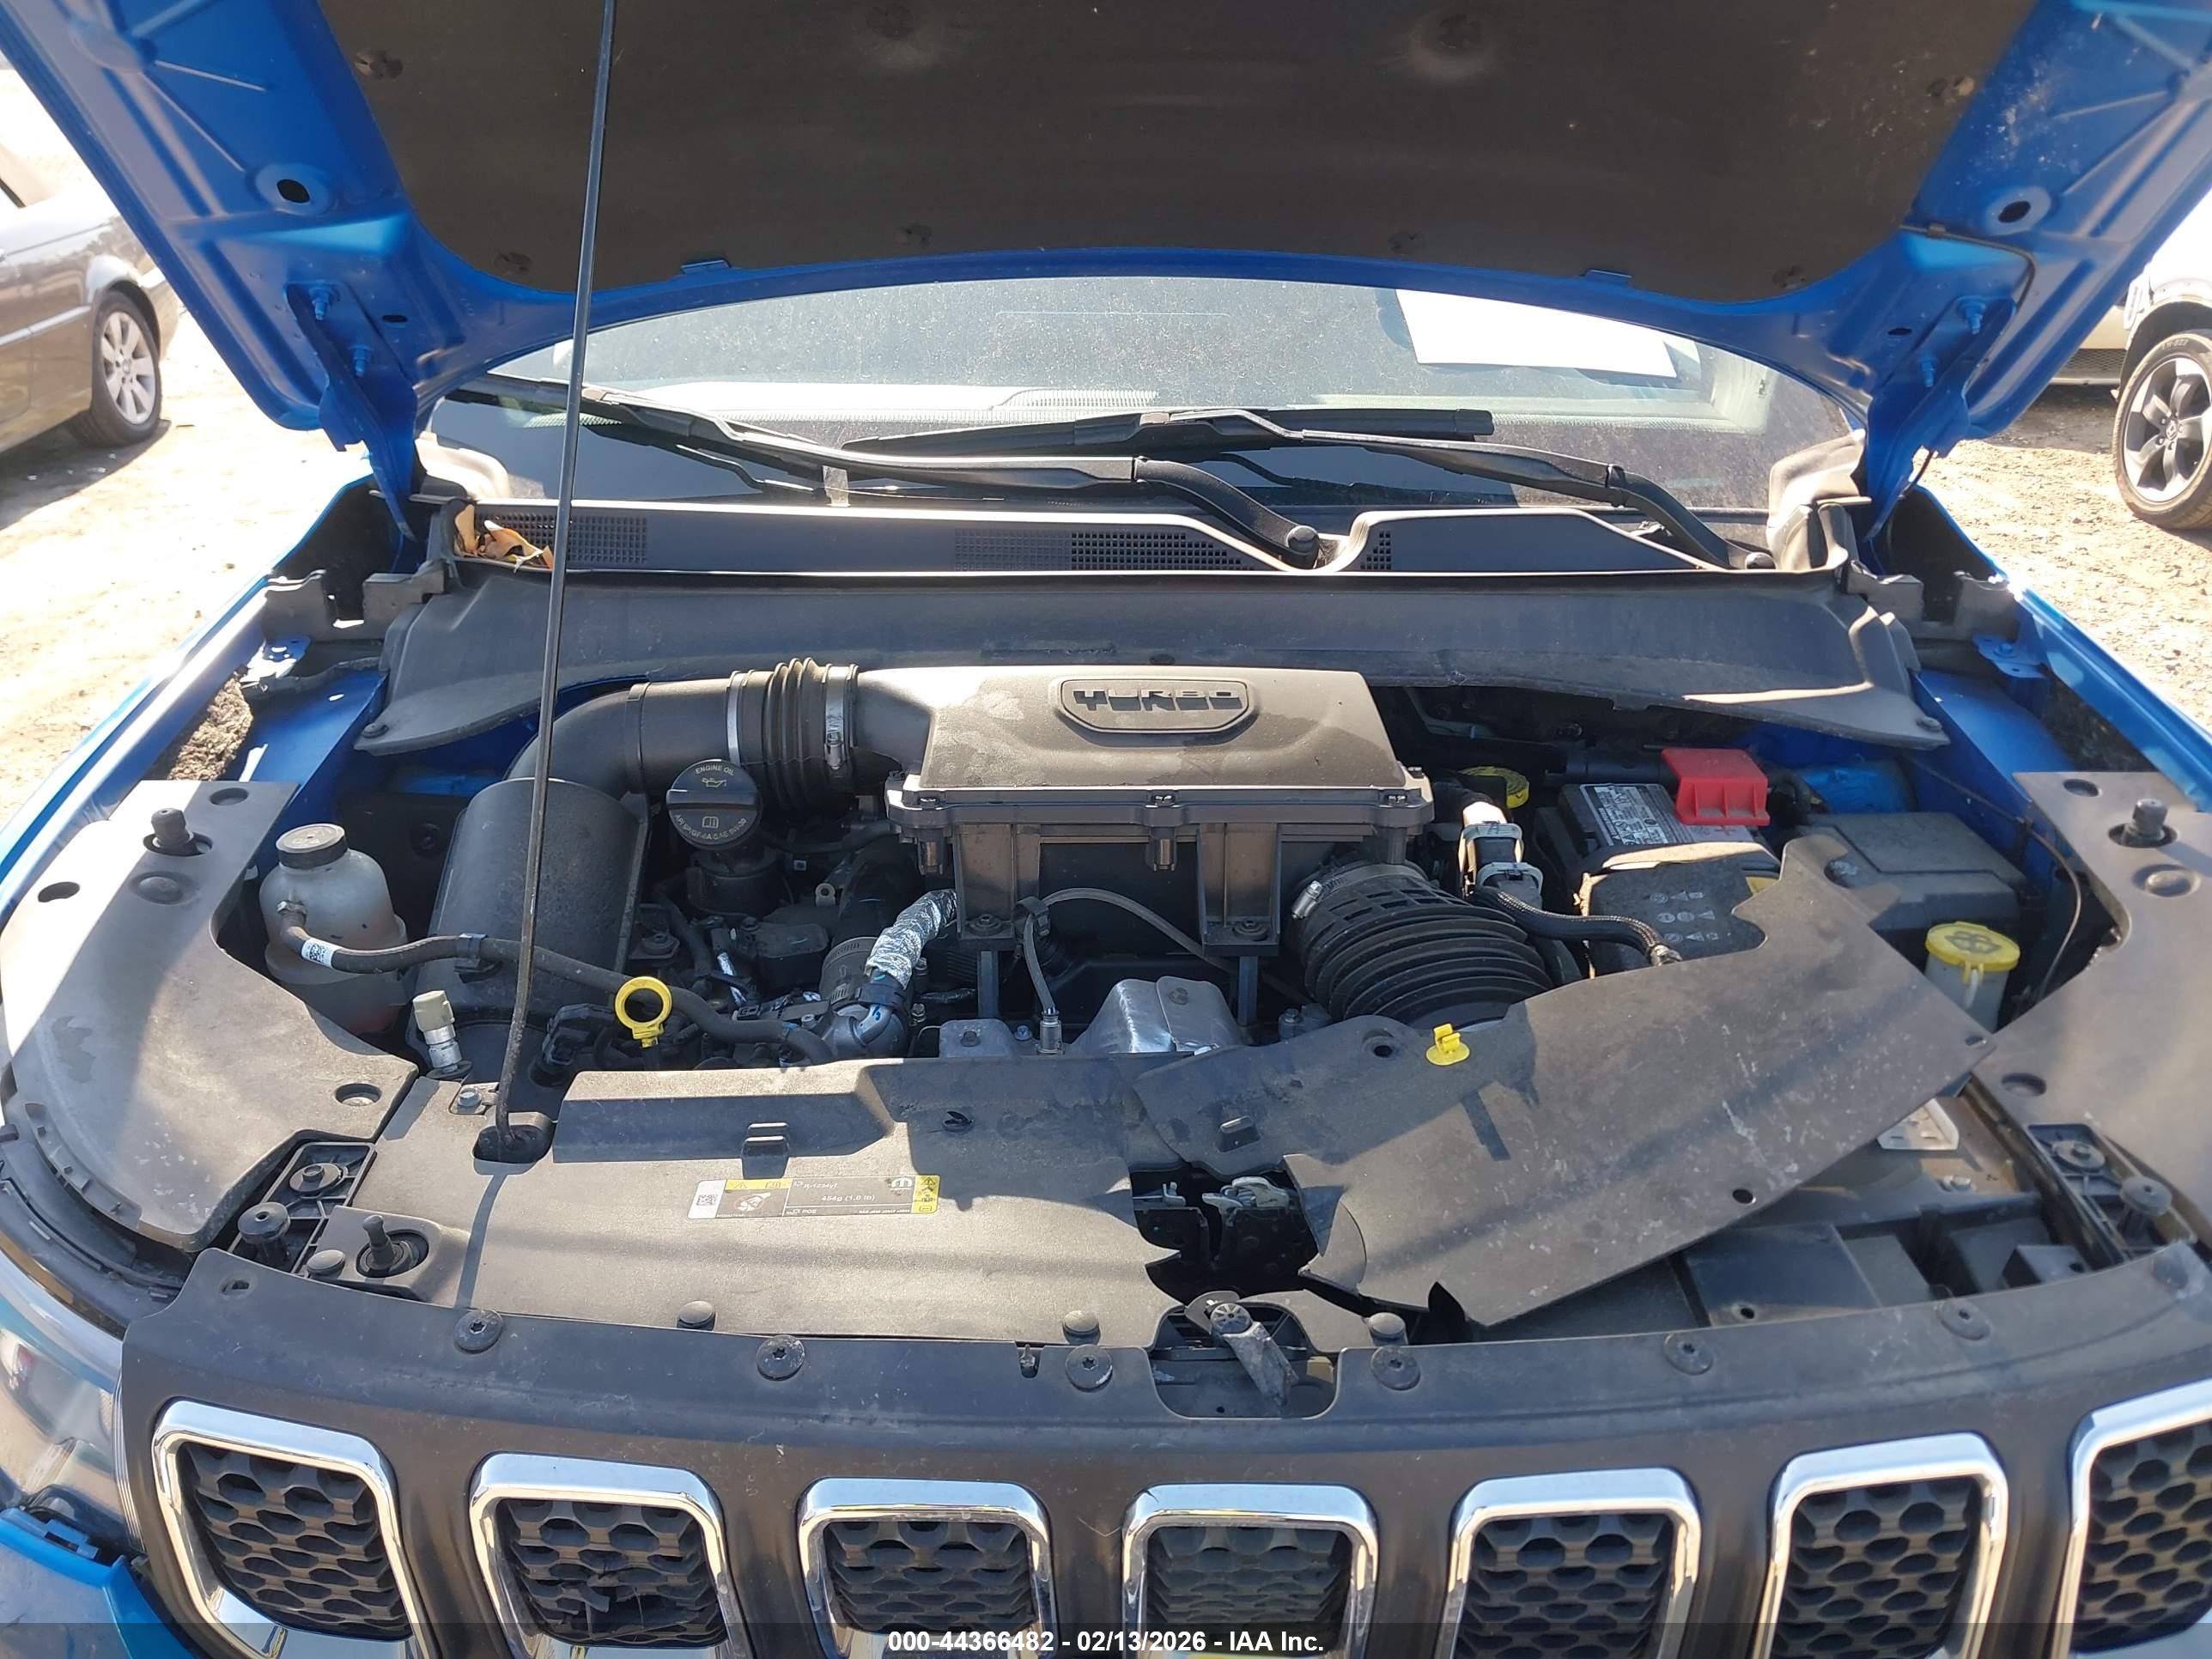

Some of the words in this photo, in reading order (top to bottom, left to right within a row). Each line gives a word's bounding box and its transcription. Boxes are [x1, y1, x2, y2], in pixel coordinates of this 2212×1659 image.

[1073, 689, 1243, 712] TURBO
[695, 764, 723, 775] ENGINE
[723, 766, 735, 776] OIL
